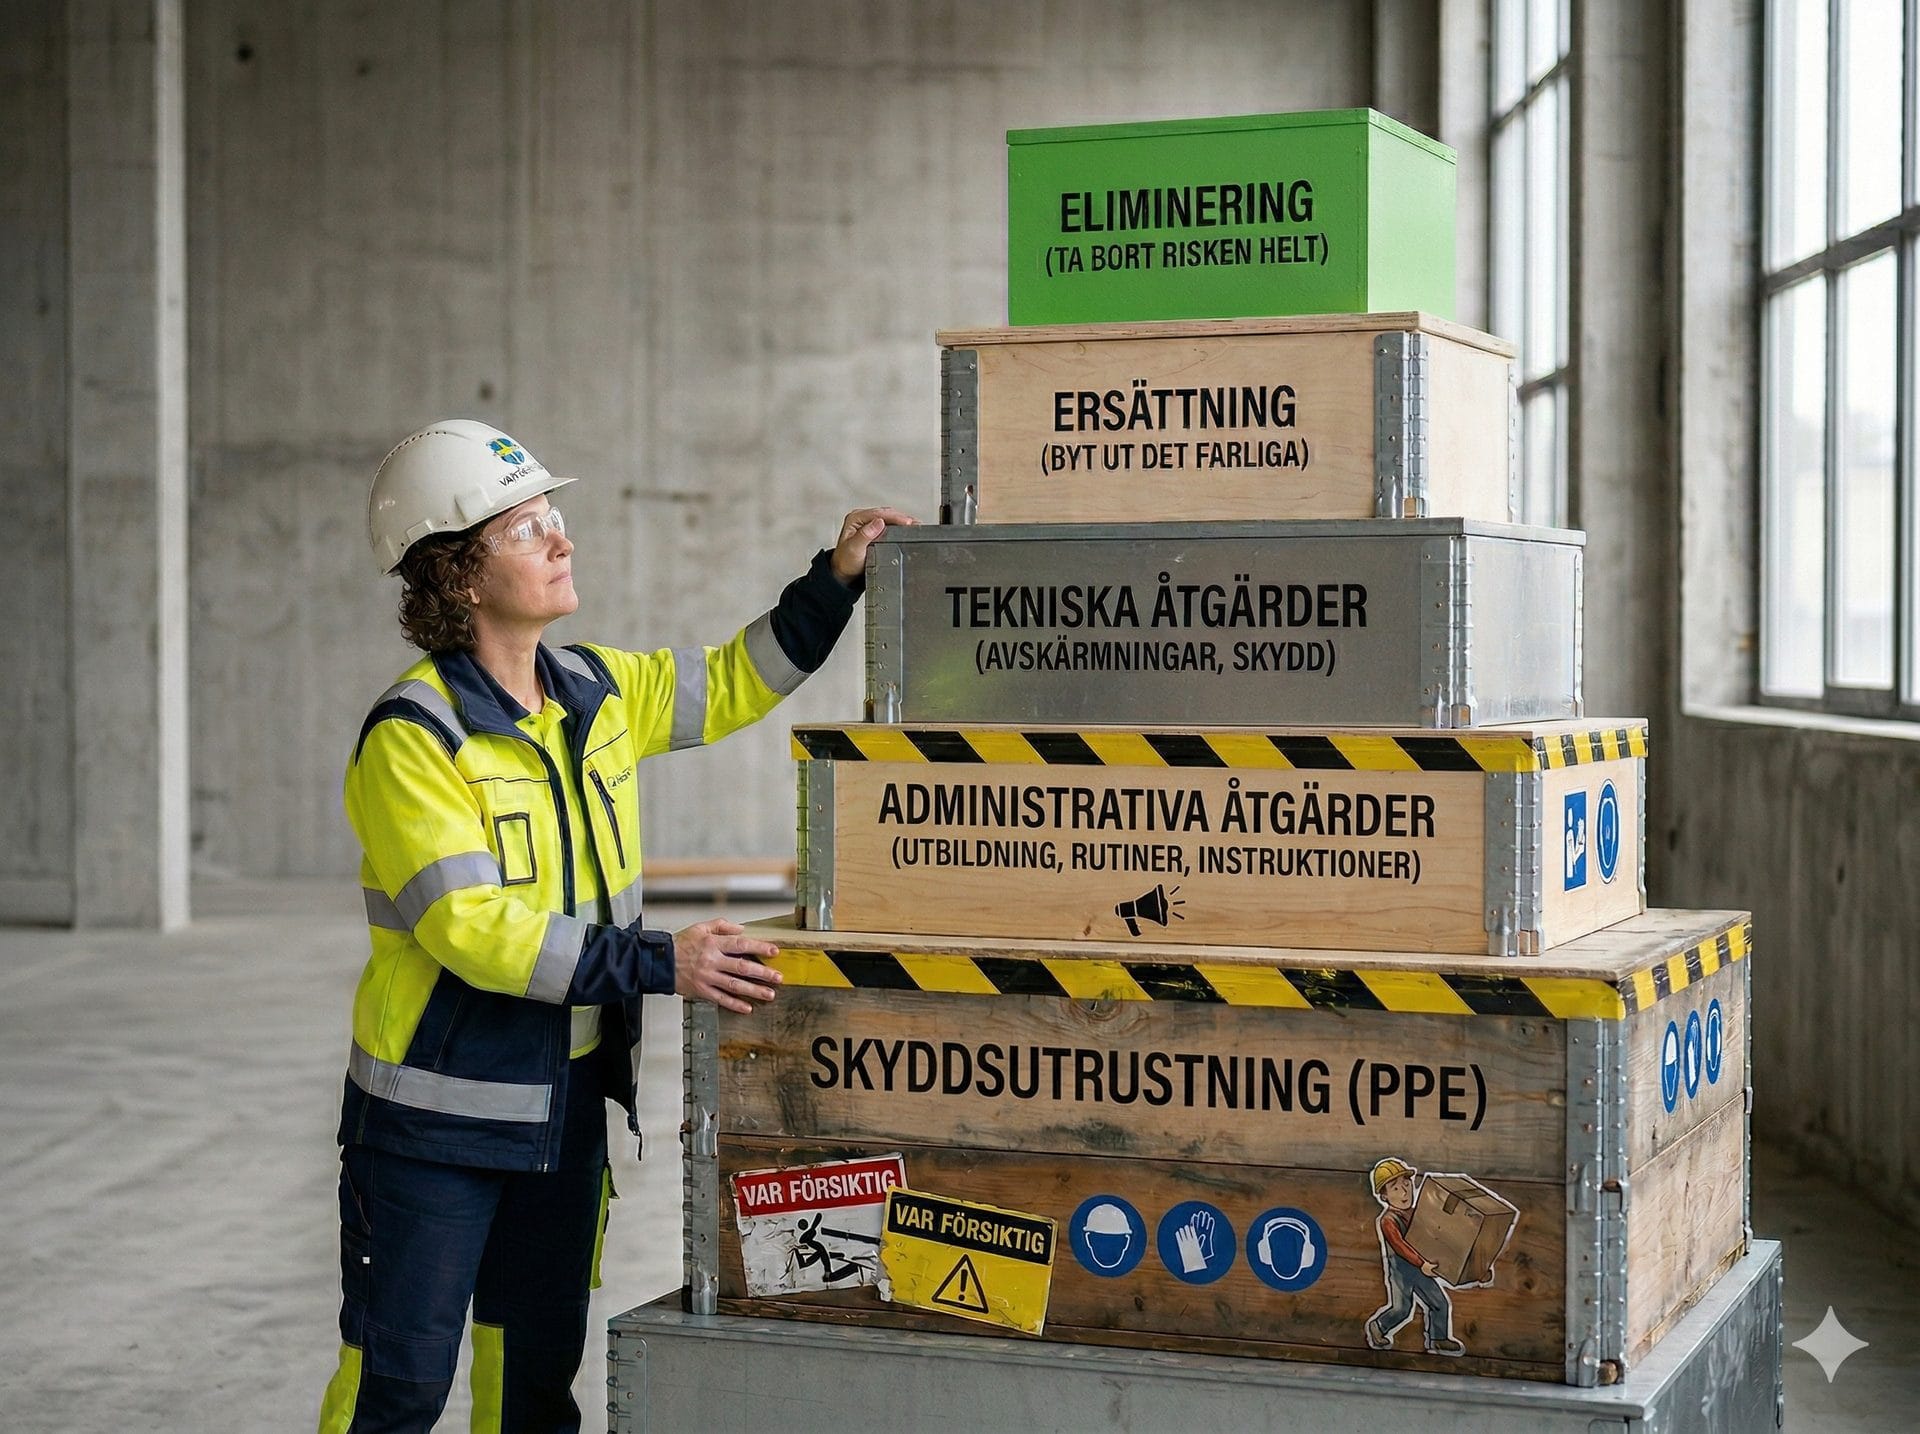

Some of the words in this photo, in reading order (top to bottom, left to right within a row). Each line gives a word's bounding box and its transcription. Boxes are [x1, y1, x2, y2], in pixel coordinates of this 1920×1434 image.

[1060, 179, 1313, 233] ELIMINERING
[1045, 245, 1083, 277] (TA
[1092, 243, 1154, 271] BORT
[1163, 238, 1252, 268] RISKEN
[1261, 232, 1329, 265] HELT)
[1054, 379, 1296, 433] ERSÄTTNING
[1040, 444, 1097, 476] (BYT
[1103, 444, 1133, 470] UT
[1142, 443, 1188, 469] DET
[1196, 438, 1309, 469] FARLIGA)
[946, 584, 1140, 629] TEKNISKA
[1152, 571, 1368, 628] ÅTGÄRDER
[975, 635, 1224, 675] (AVSKÄRMNINGAR,
[1233, 639, 1336, 677] SKYDD)
[879, 783, 1209, 833] ADMINISTRATIVA
[1222, 777, 1435, 837] ÅTGÄRDER
[892, 837, 1064, 874] (UTBILDNING,
[1072, 843, 1191, 877] RUTINER,
[1199, 847, 1422, 884] INSTRUKTIONER)
[810, 1036, 1331, 1114] SKYDDSUTRUSTNING
[1349, 1059, 1488, 1131] (PPE)
[742, 1182, 784, 1206] VAR
[790, 1170, 896, 1203] FÖRSIKTIG
[895, 1203, 933, 1230] VAR
[940, 1212, 1045, 1254] FÖRSIKTIG
